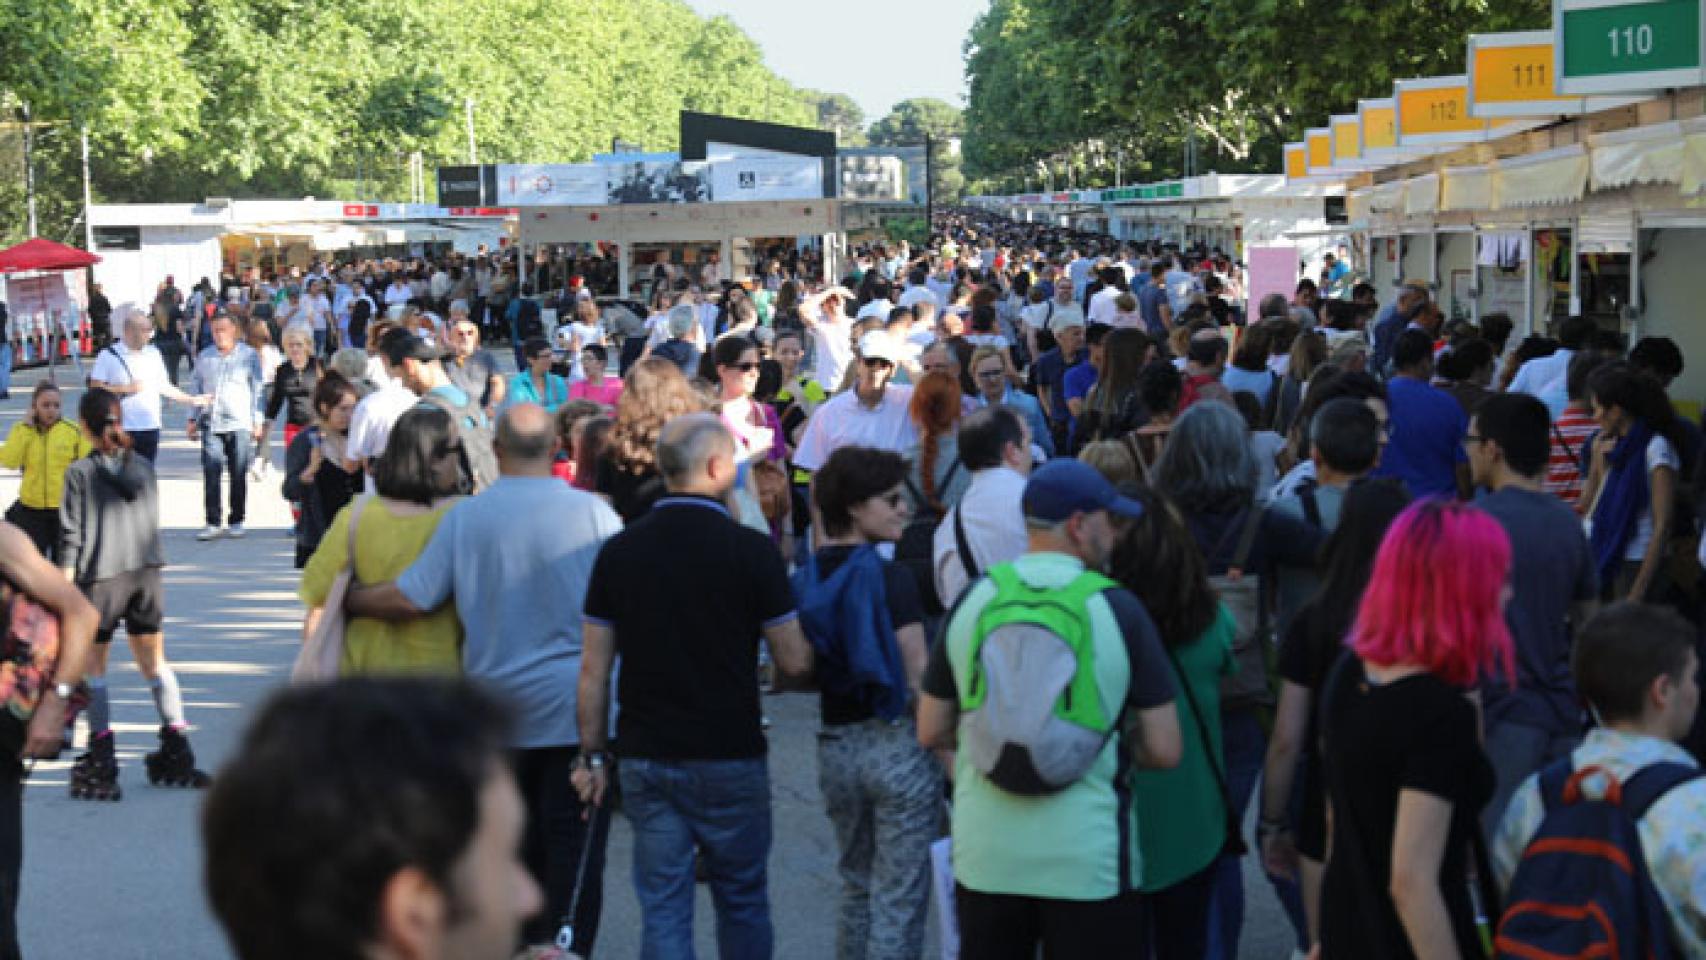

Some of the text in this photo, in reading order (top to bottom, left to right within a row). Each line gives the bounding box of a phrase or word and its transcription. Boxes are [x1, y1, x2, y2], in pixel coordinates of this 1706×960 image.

[1608, 24, 1652, 57] 110
[1513, 63, 1545, 87] 111
[1431, 100, 1456, 121] 112
